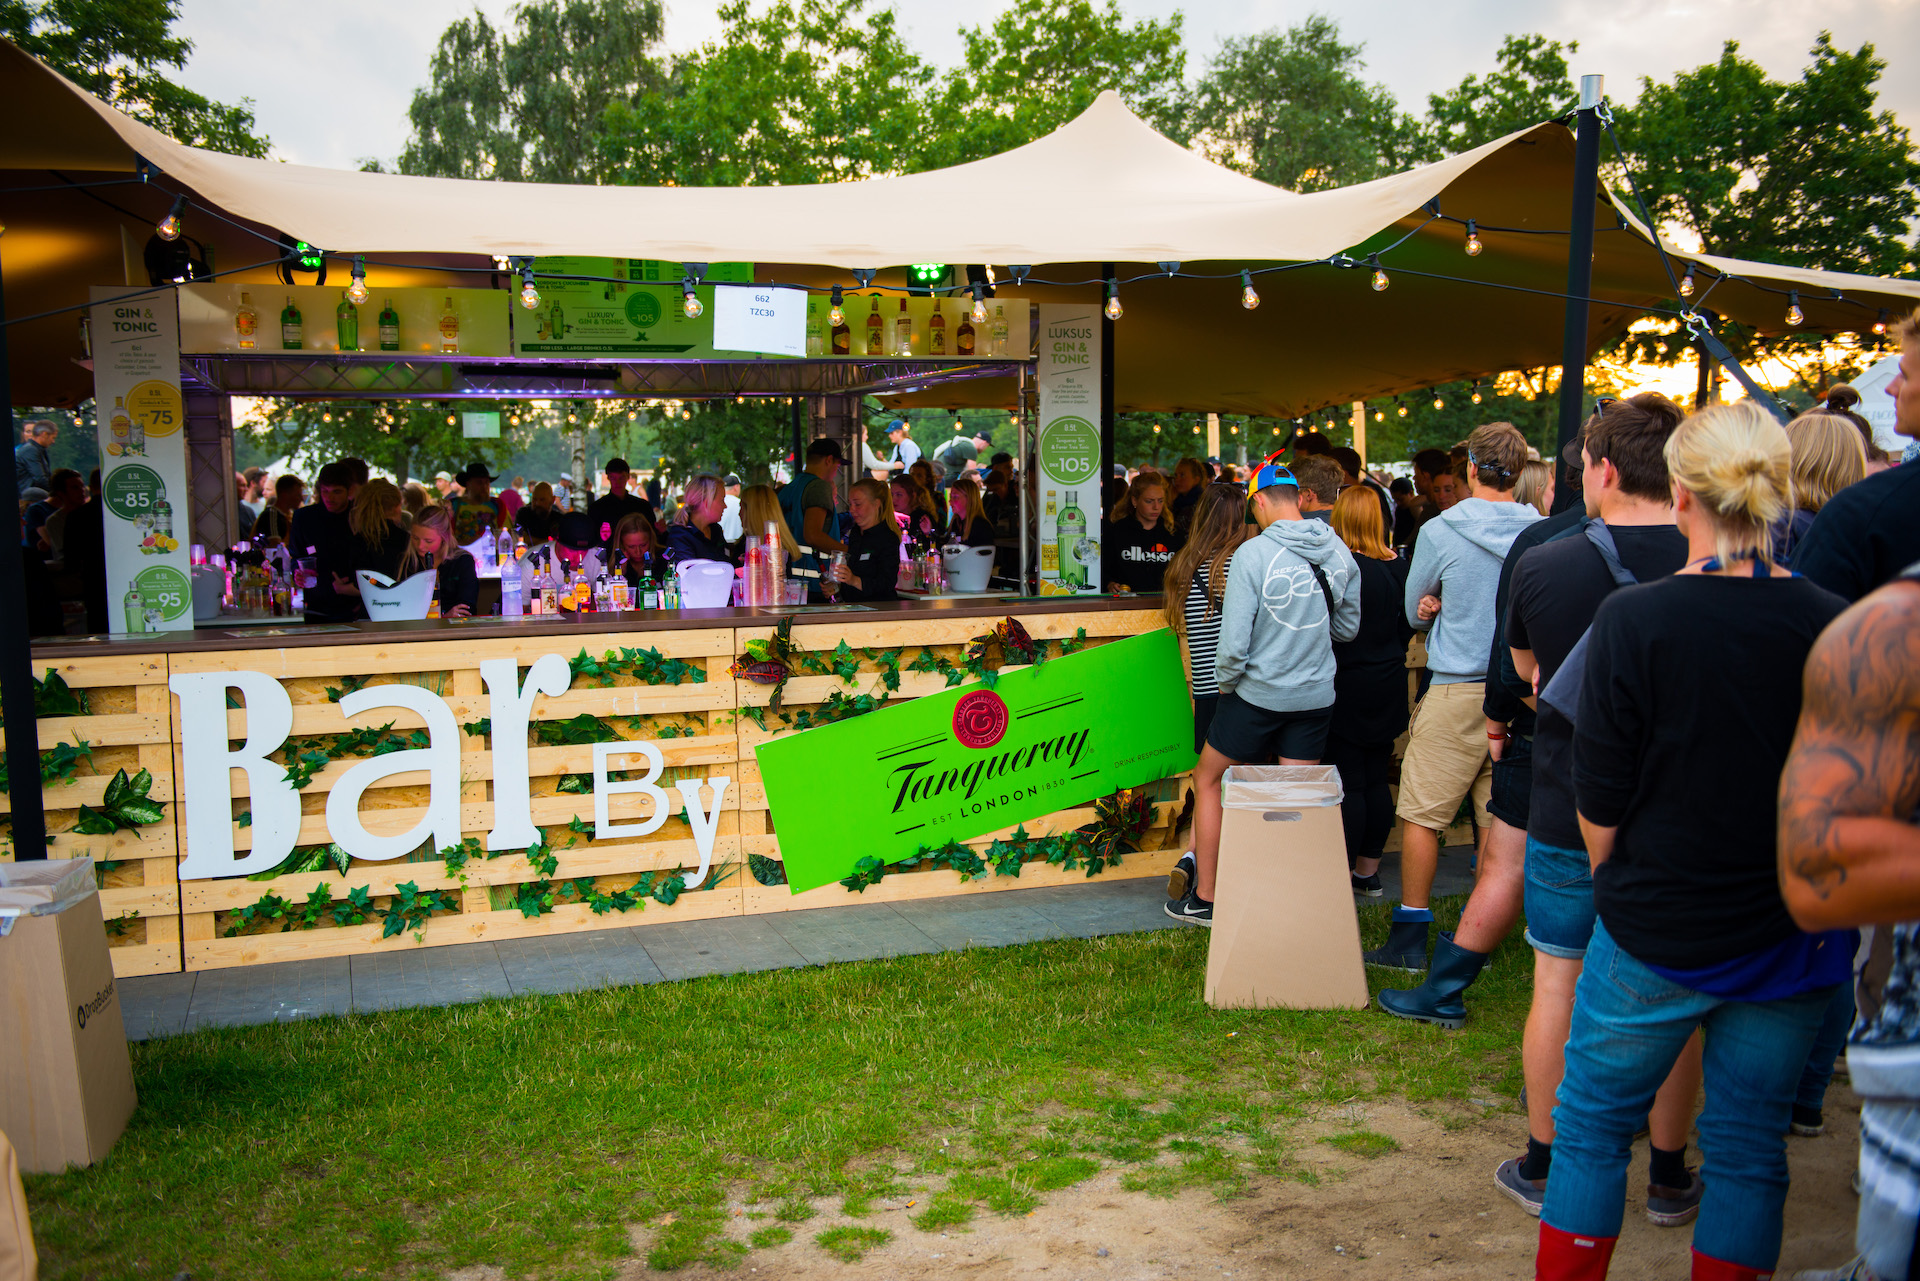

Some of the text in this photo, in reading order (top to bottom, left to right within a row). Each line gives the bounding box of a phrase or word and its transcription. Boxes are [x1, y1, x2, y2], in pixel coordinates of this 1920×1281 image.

[754, 294, 770, 304] 662
[114, 308, 153, 319] GIN &
[587, 311, 615, 319] LUXURY
[637, 313, 654, 323] 105
[749, 307, 775, 318] TZC30
[112, 321, 158, 333] TONIC
[601, 318, 625, 326] TONIC
[1048, 327, 1093, 339] LUKSUS
[1053, 341, 1087, 353] GIN &
[1051, 353, 1090, 365] TONIC
[150, 410, 174, 425] 75
[1058, 457, 1090, 472] 105
[125, 492, 150, 507] 85
[158, 592, 182, 608] 95
[1114, 742, 1181, 769] DRINK RESPONSIBLY
[169, 653, 731, 889] Bar By
[887, 728, 1090, 814] Tanqueray
[932, 779, 1066, 825] EST LONDON 1830
